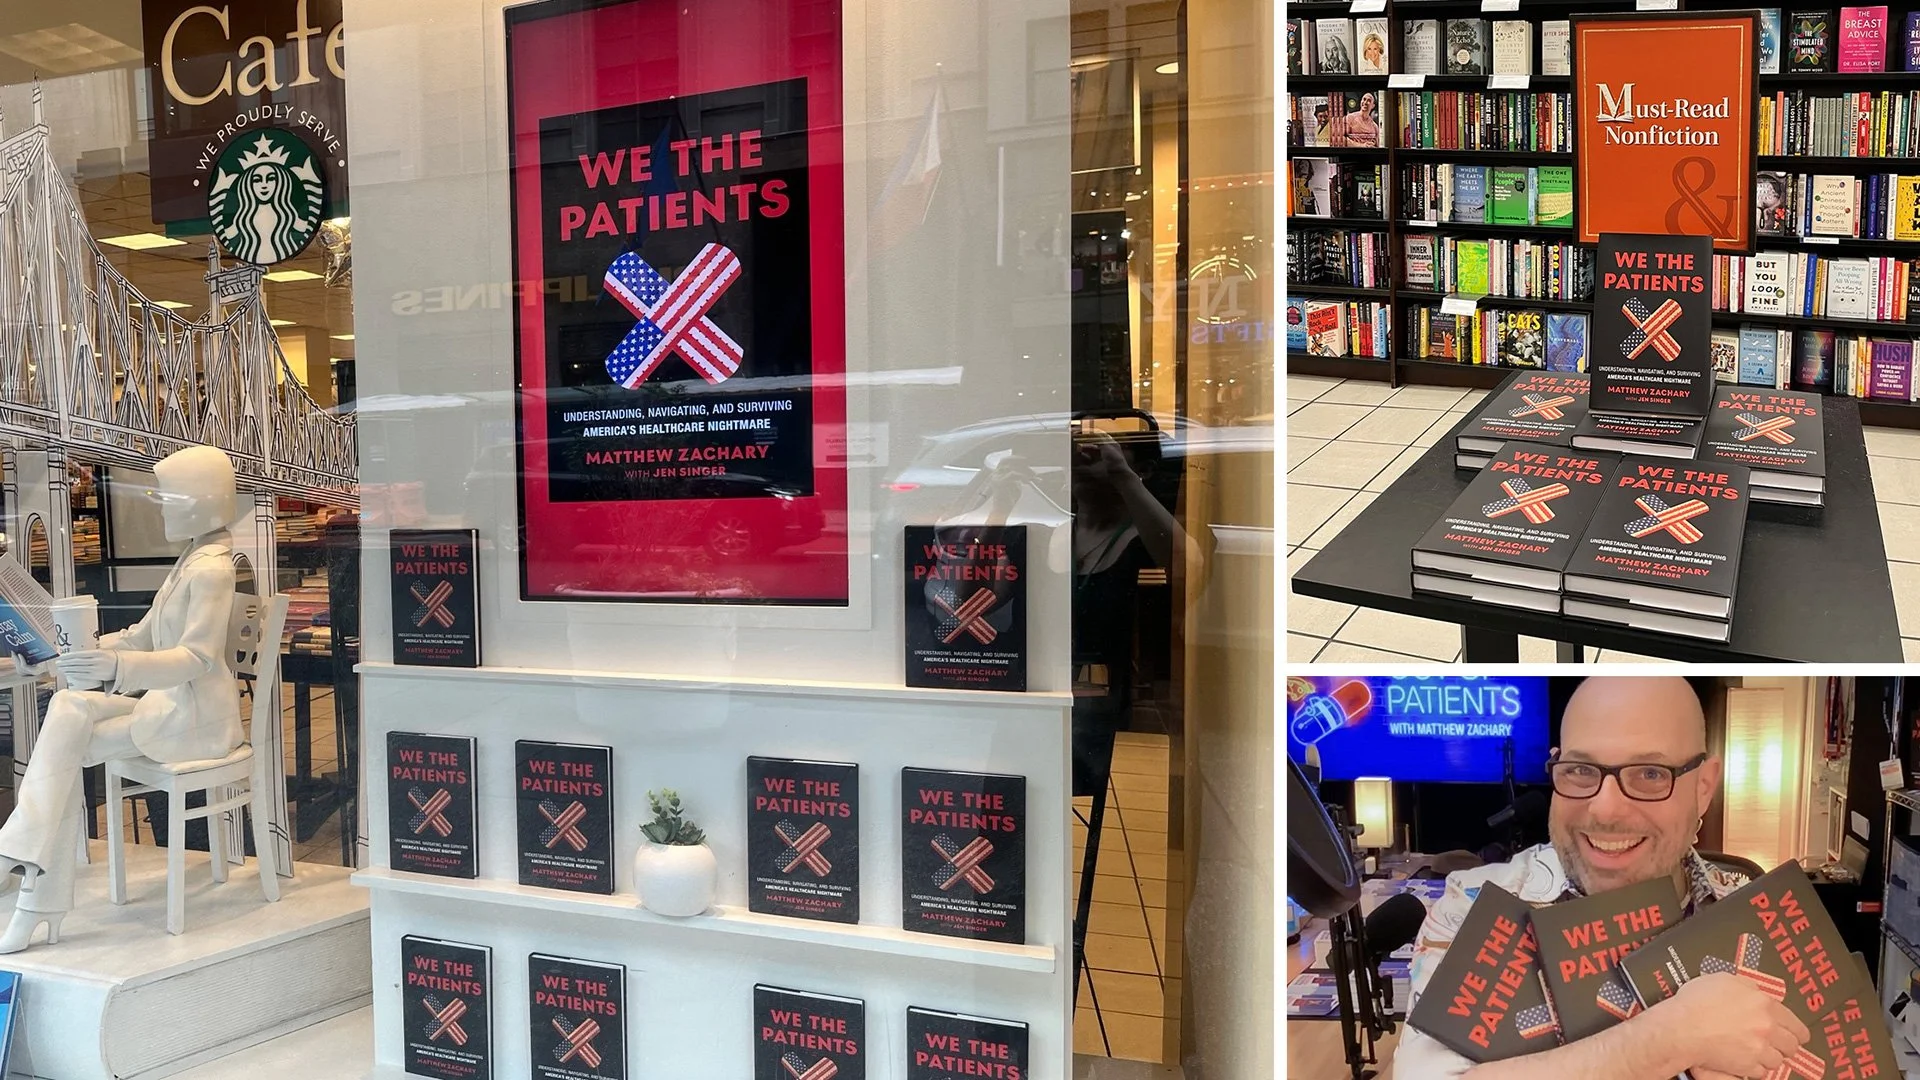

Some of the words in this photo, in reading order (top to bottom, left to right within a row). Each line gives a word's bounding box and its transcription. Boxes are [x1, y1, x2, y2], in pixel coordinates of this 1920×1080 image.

[1360, 23, 1387, 34] JOAN
[1845, 19, 1882, 28] BREAST
[1596, 83, 1729, 122] Must-Read
[196, 142, 218, 171] WE
[216, 105, 294, 142] PROUDLY
[298, 111, 340, 153] SERVE
[1605, 125, 1719, 146] Nonfiction
[578, 145, 652, 189] WE
[670, 129, 763, 176] THE
[560, 180, 790, 241] PATIENTS
[1615, 252, 1648, 268] WE
[1655, 253, 1694, 270] THE
[1604, 273, 1704, 293] PATIENTS
[1752, 285, 1779, 293] LOOK
[1508, 313, 1540, 330] CATS
[1876, 343, 1910, 362] HUSH
[1513, 383, 1590, 395] PATIENT
[1530, 376, 1558, 386] WE
[1608, 386, 1649, 395] MATTHEW
[1650, 388, 1690, 397] ZACHARY
[1730, 393, 1761, 403] WE
[1769, 396, 1806, 406] THE
[563, 409, 645, 422] UNDERSTANDING,
[648, 405, 710, 419] NAVIGATING,
[712, 403, 734, 415] AND
[737, 400, 792, 413] SURVIVING
[1718, 401, 1817, 416] PATIENTS
[583, 424, 636, 438] AMERICA'S
[639, 422, 705, 435] HEALTHCARE
[708, 419, 771, 432] NIGHTMARE
[585, 449, 673, 465] MATTHEW
[678, 445, 769, 461] ZACHARY
[1513, 451, 1549, 465] WE
[1557, 457, 1600, 471] THE
[624, 469, 649, 479] WITH
[653, 468, 676, 478] JEN
[679, 466, 726, 477] SINGER
[1490, 461, 1603, 484] PATIENTS
[1638, 465, 1675, 479] WE
[1684, 470, 1729, 485] THE
[1619, 477, 1739, 500] PATIENTS
[1445, 518, 1490, 528] UNDERSTANDING,
[1492, 524, 1525, 533] NAVIGATING,
[1540, 530, 1570, 540] SURVIVING
[1451, 525, 1483, 534] AMERICA'S
[1483, 529, 1520, 539] HEALTHCARE
[1520, 534, 1555, 543] NIGHTMARE
[401, 544, 425, 558] WE
[431, 544, 459, 558] THE
[923, 545, 957, 560] WE
[966, 545, 1007, 560] THE
[1444, 533, 1497, 546] MATTHEW
[1497, 541, 1549, 553] ZACHARY
[1494, 547, 1521, 555] SINGER
[1590, 538, 1640, 549] UNDERSTANDING,
[1641, 544, 1678, 554] NAVIGATING,
[1694, 551, 1727, 561] SURVIVING
[1598, 545, 1633, 555] AMERICA'S
[1633, 550, 1674, 561] HEALTHCARE
[1675, 556, 1713, 565] NIGHTMARE
[395, 562, 468, 575] PATIENTS
[914, 565, 1019, 582] PATIENTS
[1595, 555, 1652, 568] MATTHEW
[1653, 563, 1710, 576] ZACHARY
[1652, 570, 1682, 579] SINGER
[5, 632, 36, 646] Calm
[55, 624, 72, 646] &
[967, 669, 1008, 677] ZACHARY
[1387, 685, 1522, 716] PATIENTS
[1389, 723, 1415, 735] WITH
[1417, 723, 1464, 735] MATTHEW
[1467, 724, 1512, 736] ZACHARY
[400, 749, 423, 764] WE
[428, 752, 458, 767] THE
[392, 766, 467, 785] PATIENTS
[529, 759, 555, 775] WE
[561, 762, 593, 778] THE
[522, 777, 603, 797] PATIENTS
[764, 777, 795, 794] WE
[802, 780, 840, 797] THE
[756, 796, 851, 818] PATIENTS
[919, 789, 954, 806] WE
[962, 792, 1004, 811] THE
[909, 808, 1016, 832] PATIENTS
[1562, 920, 1608, 949] WE
[1613, 905, 1664, 935] THE
[1778, 889, 1811, 936] WE
[1804, 935, 1840, 988] THE
[1749, 891, 1825, 1013] PATIENTS
[413, 955, 438, 973] WE
[444, 960, 473, 978] THE
[1447, 971, 1488, 1018] WE
[1475, 915, 1518, 967] THE
[408, 972, 482, 996] PATIENTS
[542, 974, 569, 991] WE
[575, 979, 607, 997] THE
[1468, 921, 1539, 1049] PATIENT
[535, 991, 617, 1016] PATIENTS
[1845, 999, 1862, 1023] E
[770, 1009, 801, 1027] WE
[809, 1015, 847, 1034] THE
[762, 1026, 857, 1056] PATIENTS
[925, 1032, 960, 1052] WE
[968, 1039, 1009, 1060] THE
[1851, 1027, 1879, 1079] THE
[916, 1051, 1020, 1080] PATIENTS
